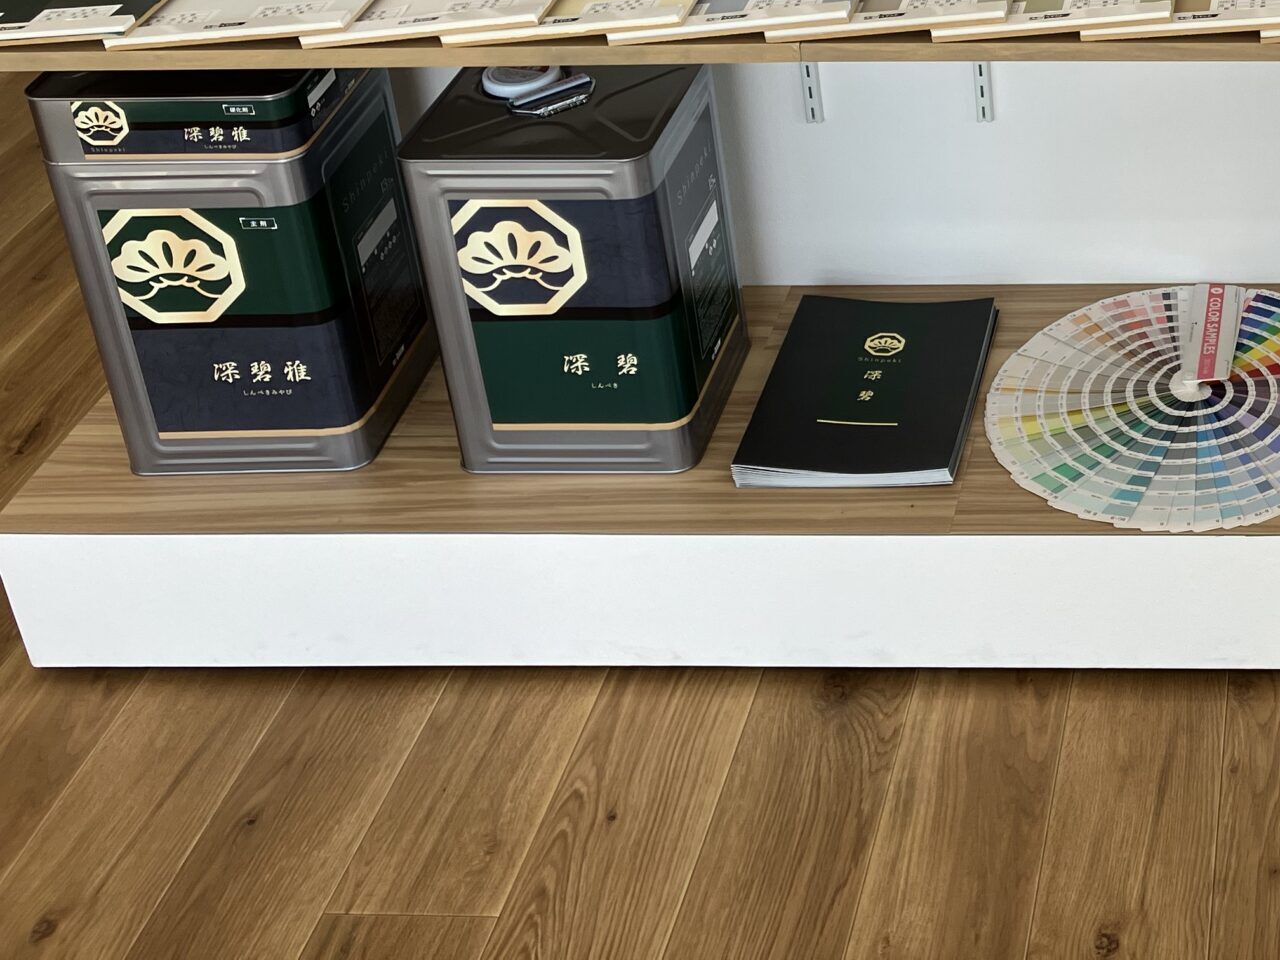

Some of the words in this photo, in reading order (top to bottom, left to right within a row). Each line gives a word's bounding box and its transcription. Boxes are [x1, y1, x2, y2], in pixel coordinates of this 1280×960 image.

[184, 127, 251, 142] 深碧雅
[1208, 297, 1221, 322] COLOR
[1203, 322, 1219, 355] SAMPLES
[213, 360, 312, 383] 深碧雅
[563, 353, 638, 375] 深碧
